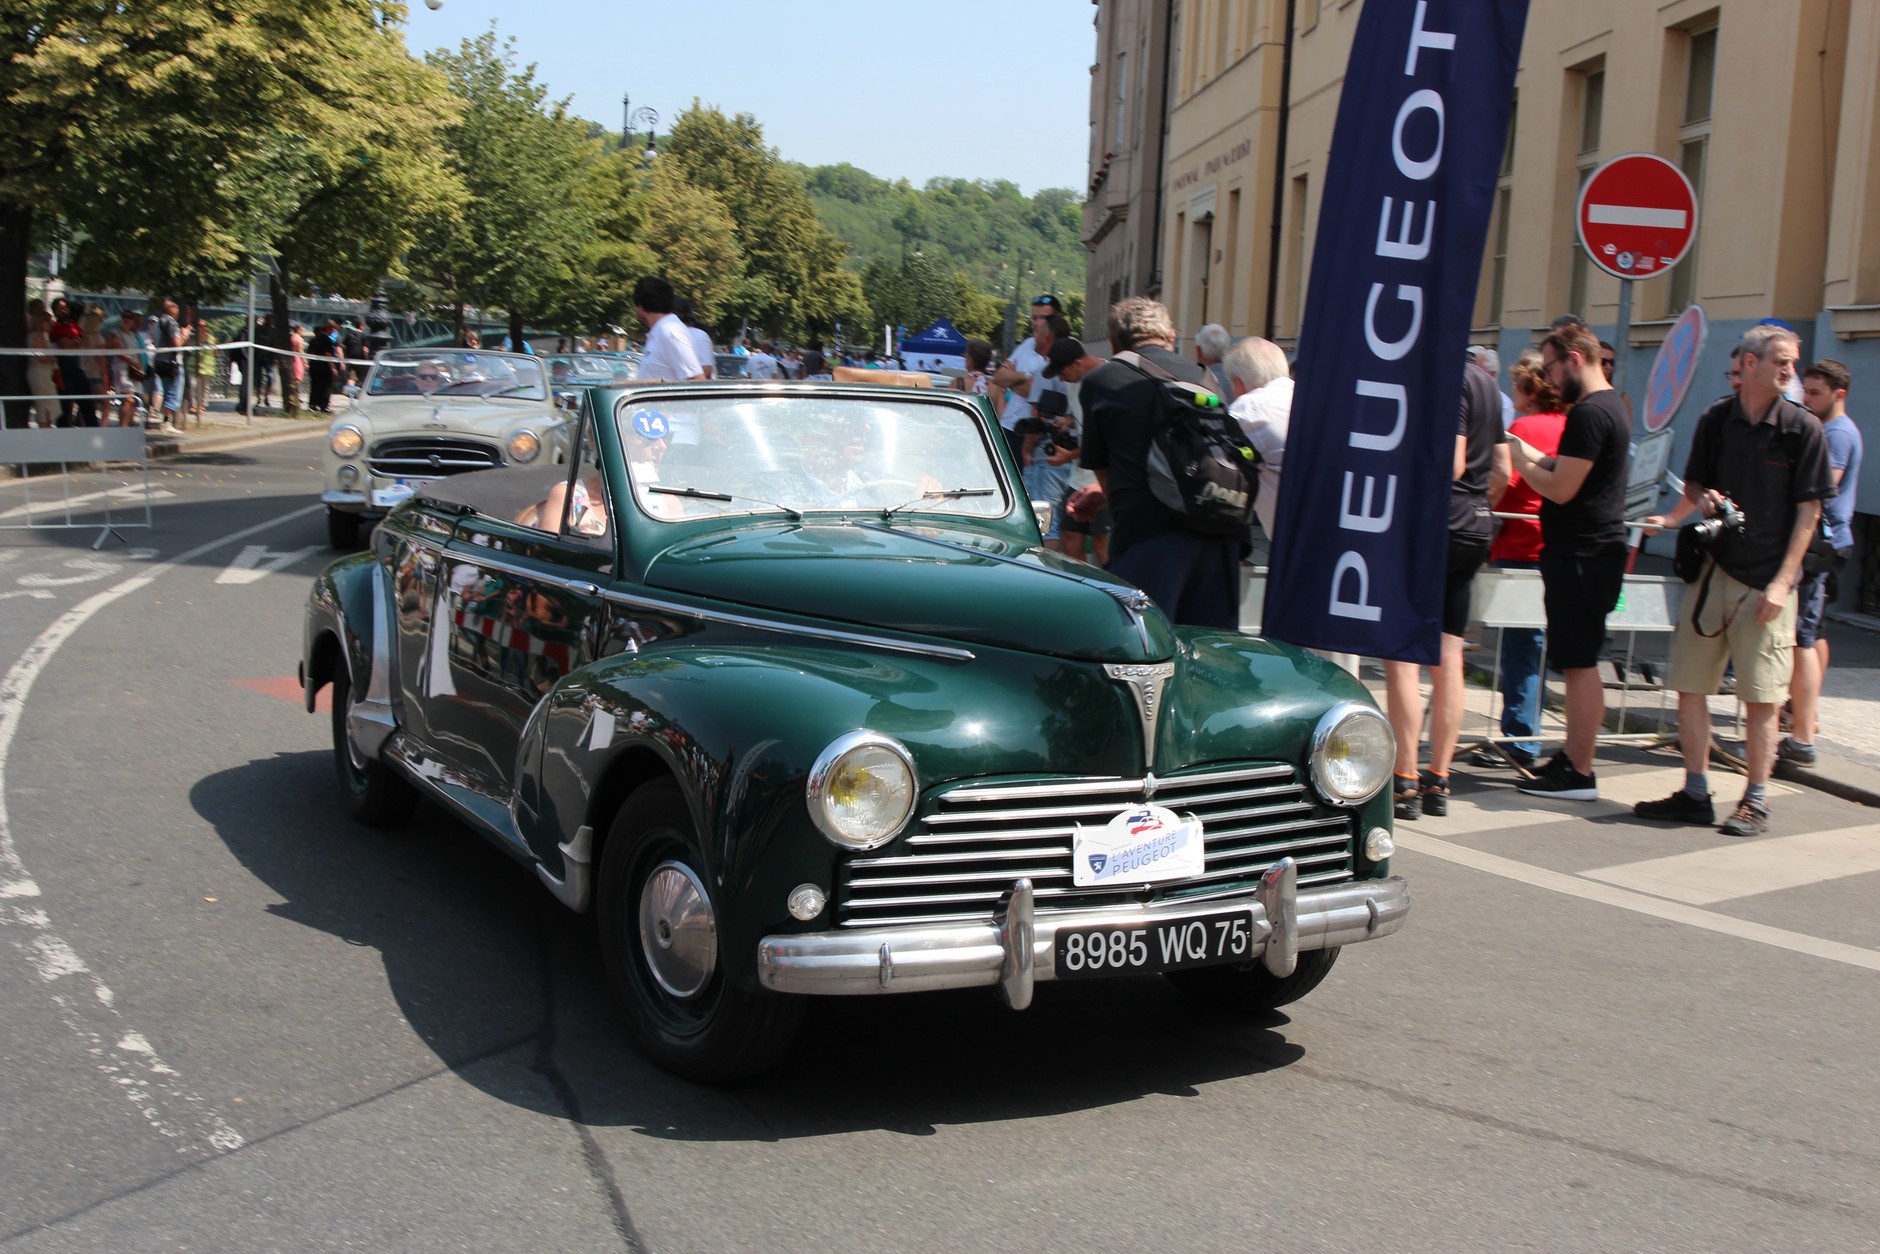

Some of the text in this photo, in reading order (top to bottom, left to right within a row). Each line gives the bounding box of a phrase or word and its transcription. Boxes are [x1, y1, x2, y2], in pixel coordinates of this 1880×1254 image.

[1328, 0, 1458, 622] PEUGEOT
[639, 417, 665, 433] 14
[1112, 829, 1177, 863] L'AVENTURE
[1112, 842, 1177, 877] PEUGEOT
[1065, 918, 1248, 971] 8985 WQ 75
